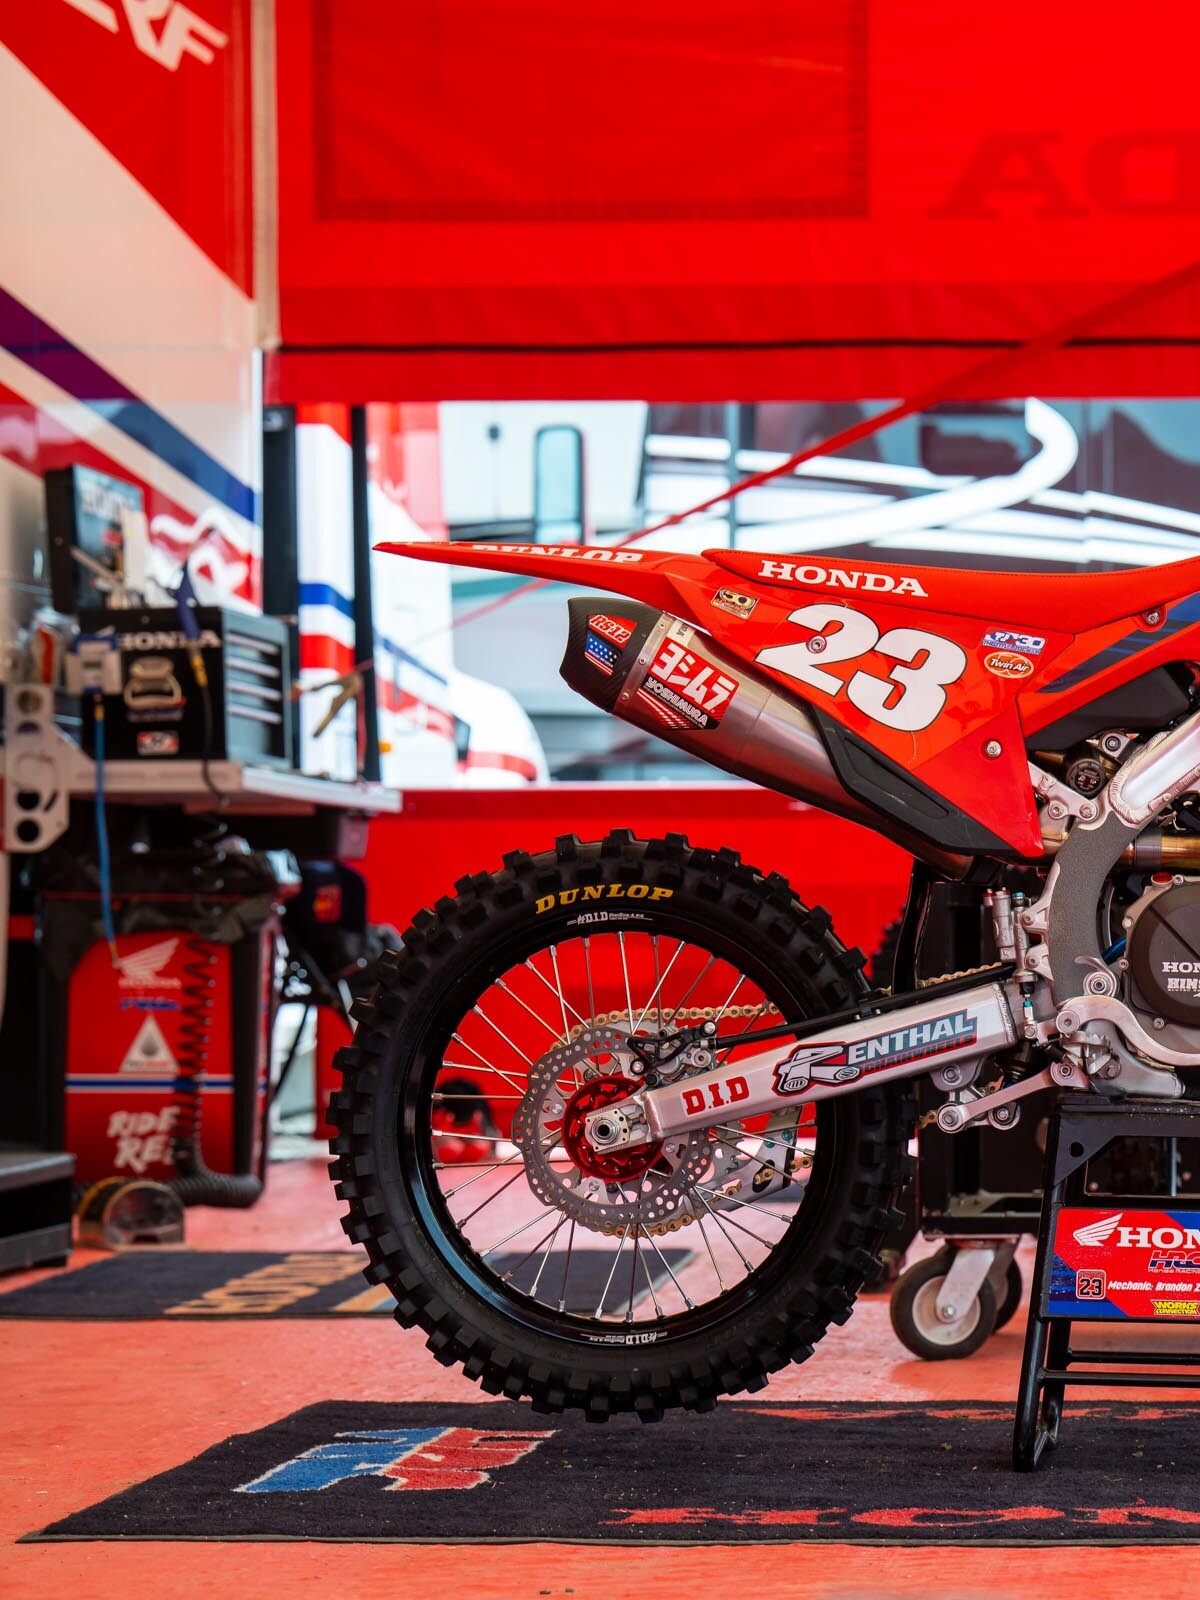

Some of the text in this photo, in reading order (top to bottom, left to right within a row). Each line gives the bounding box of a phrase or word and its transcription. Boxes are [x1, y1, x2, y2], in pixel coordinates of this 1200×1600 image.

[62, 0, 228, 71] RF
[758, 559, 929, 598] HONDA
[121, 631, 221, 650] HONA
[650, 642, 736, 711] ヨシムラ
[753, 602, 968, 732] 23
[990, 658, 1030, 672] Twin Air
[644, 677, 709, 728] YOSHIMURA
[535, 883, 674, 915] DUNLOP
[863, 1033, 976, 1074] CHAINWHEELS
[682, 1076, 749, 1116] D.I.D
[1079, 1277, 1103, 1297] 23
[1108, 1280, 1153, 1291] Mechanic:
[1156, 1282, 1193, 1292] Brandon
[1153, 1301, 1200, 1309] WORKS
